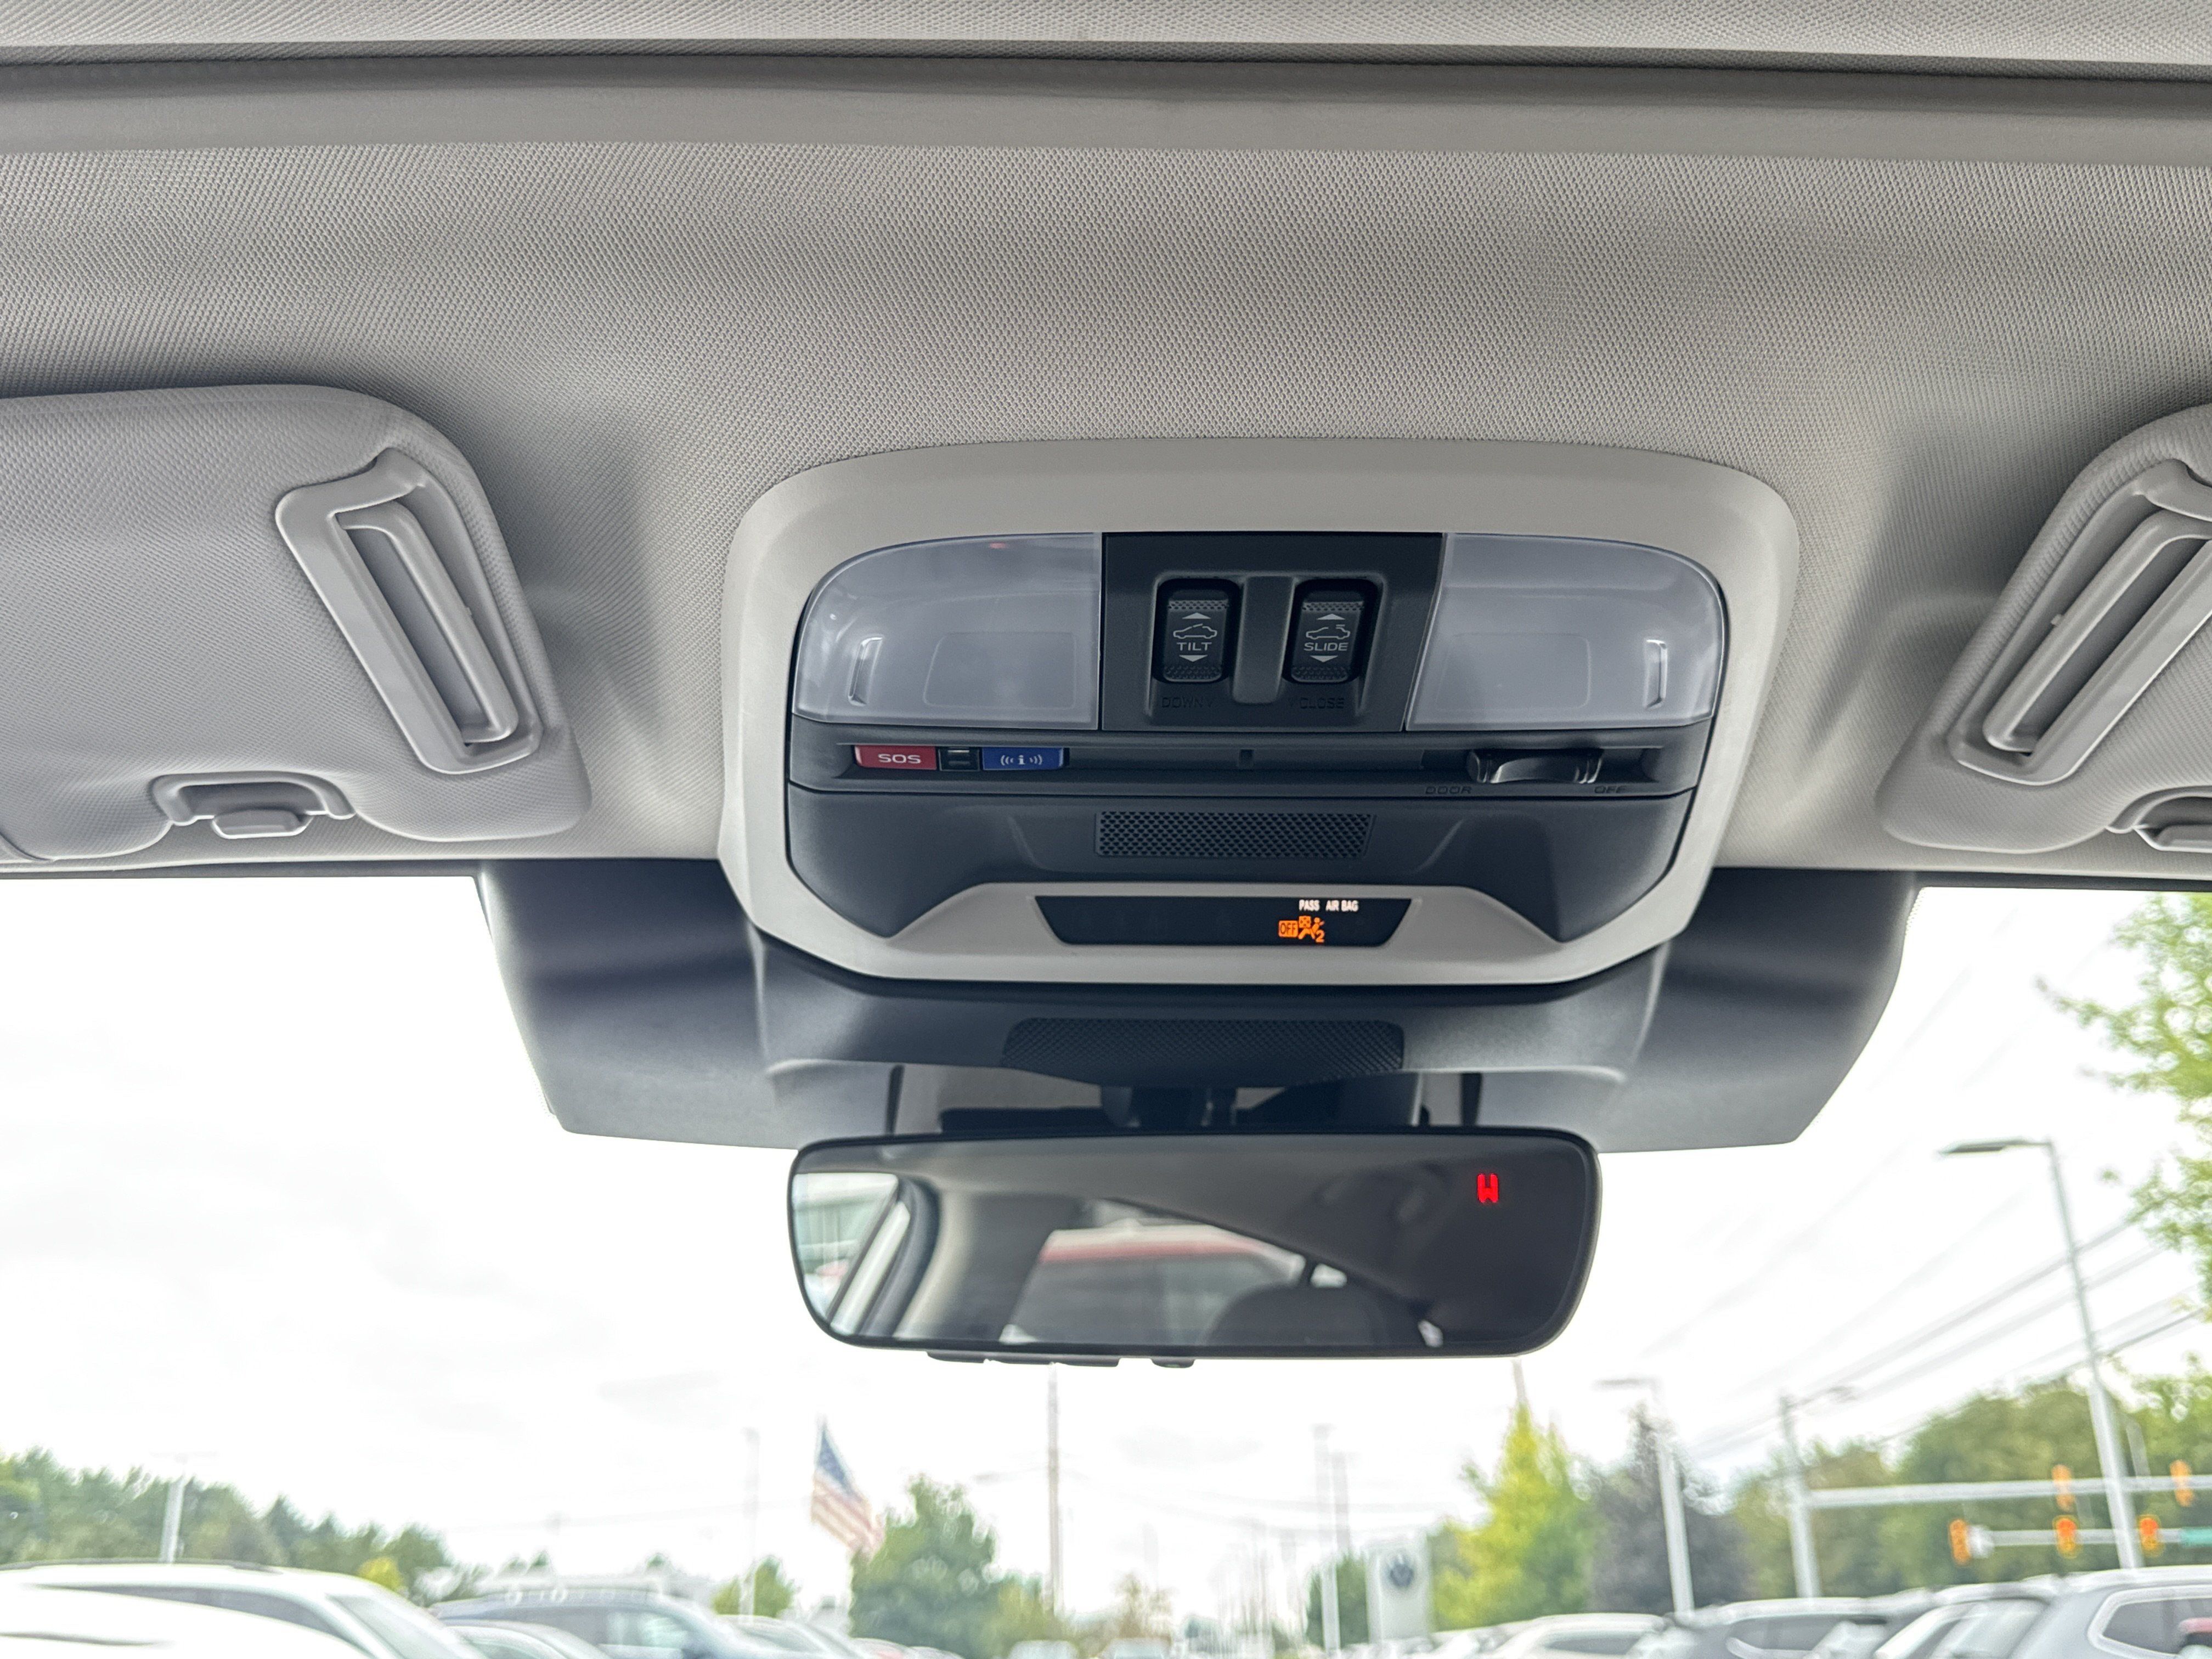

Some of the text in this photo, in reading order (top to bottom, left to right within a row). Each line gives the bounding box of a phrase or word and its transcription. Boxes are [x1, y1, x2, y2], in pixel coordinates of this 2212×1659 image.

[1176, 642, 1212, 651] TILT
[1303, 642, 1349, 652] SLIDE
[1161, 697, 1204, 708] DOWN
[1300, 697, 1345, 709] CLOSE
[878, 753, 922, 764] SOS
[1425, 786, 1472, 795] DOOR
[1594, 785, 1627, 794] OFF
[1299, 900, 1359, 912] PASS AIR BAG
[1279, 922, 1325, 943] OFF 2
[1477, 1173, 1499, 1203] W
